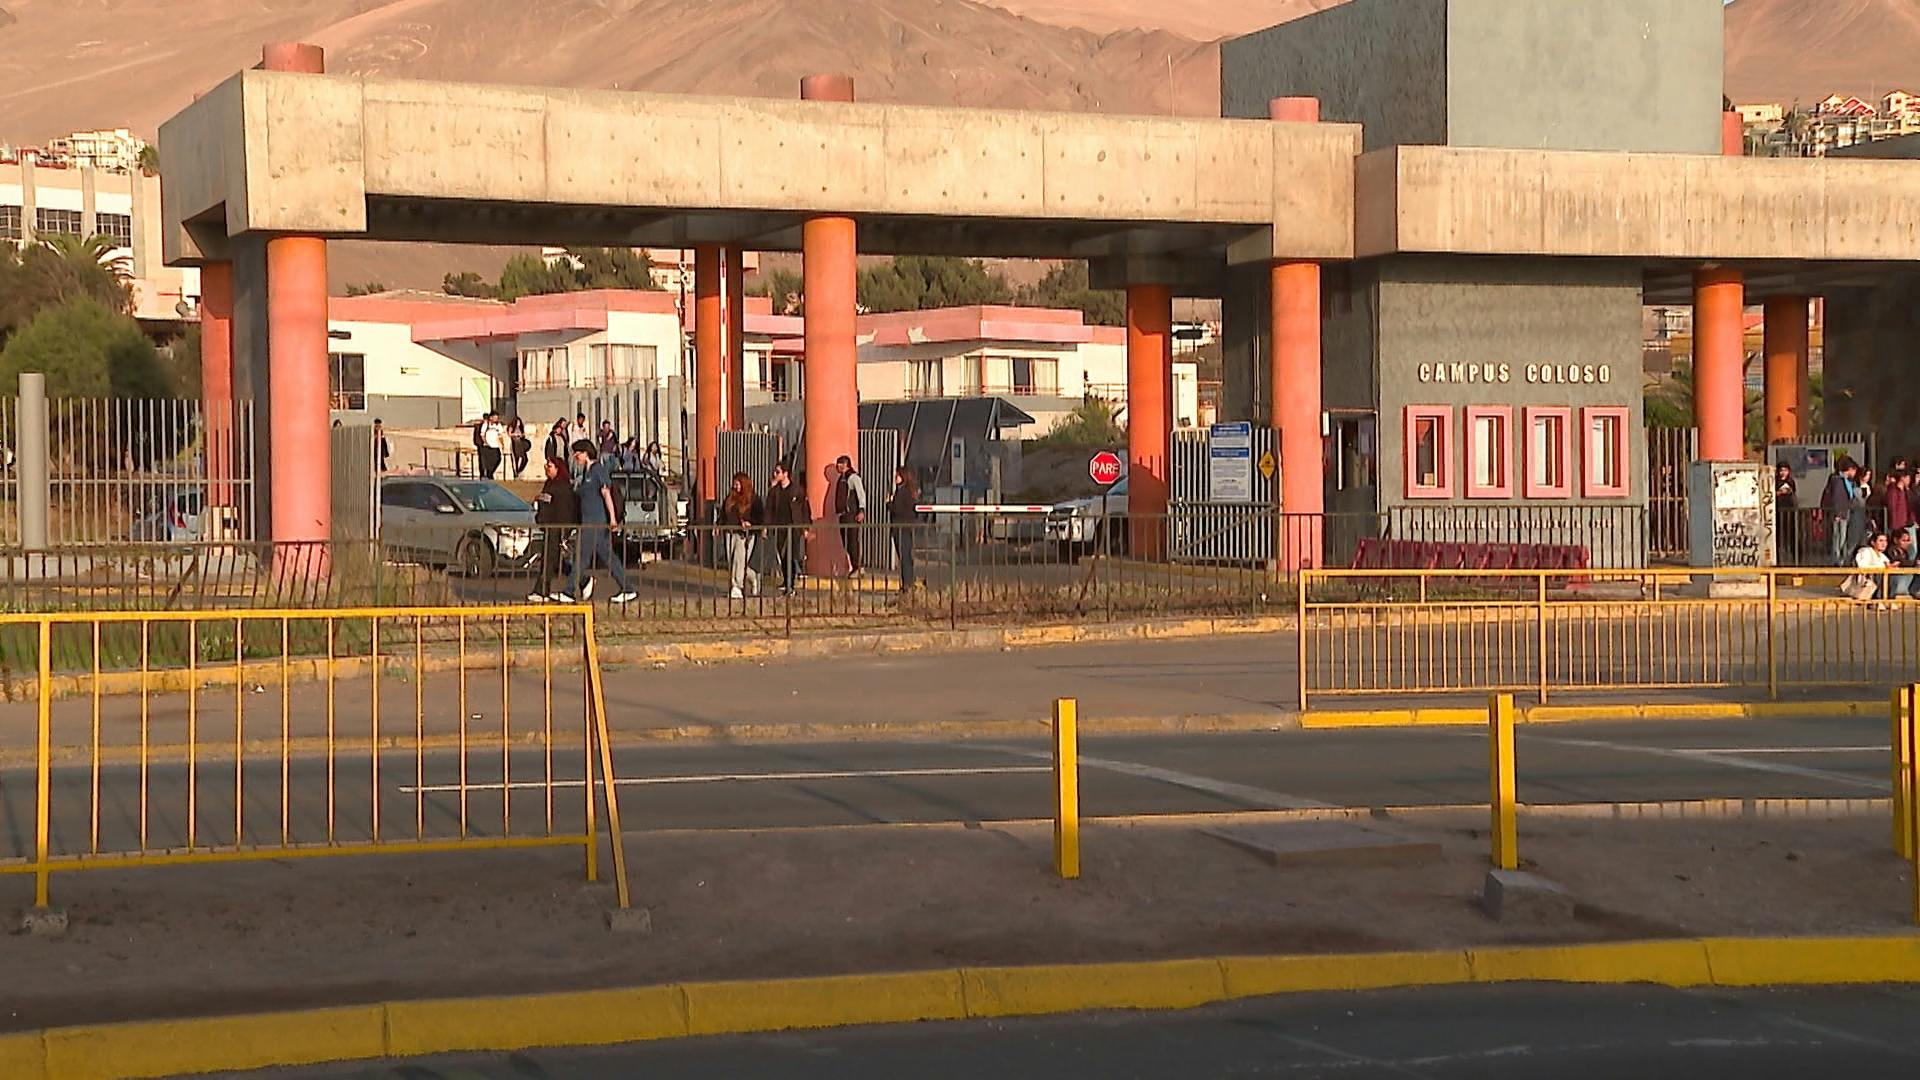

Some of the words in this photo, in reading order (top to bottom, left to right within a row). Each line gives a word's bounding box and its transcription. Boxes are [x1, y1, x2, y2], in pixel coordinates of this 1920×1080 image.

[1419, 363, 1510, 383] CAMPUS
[1526, 364, 1611, 384] COLOSO
[1092, 461, 1119, 475] PARE
